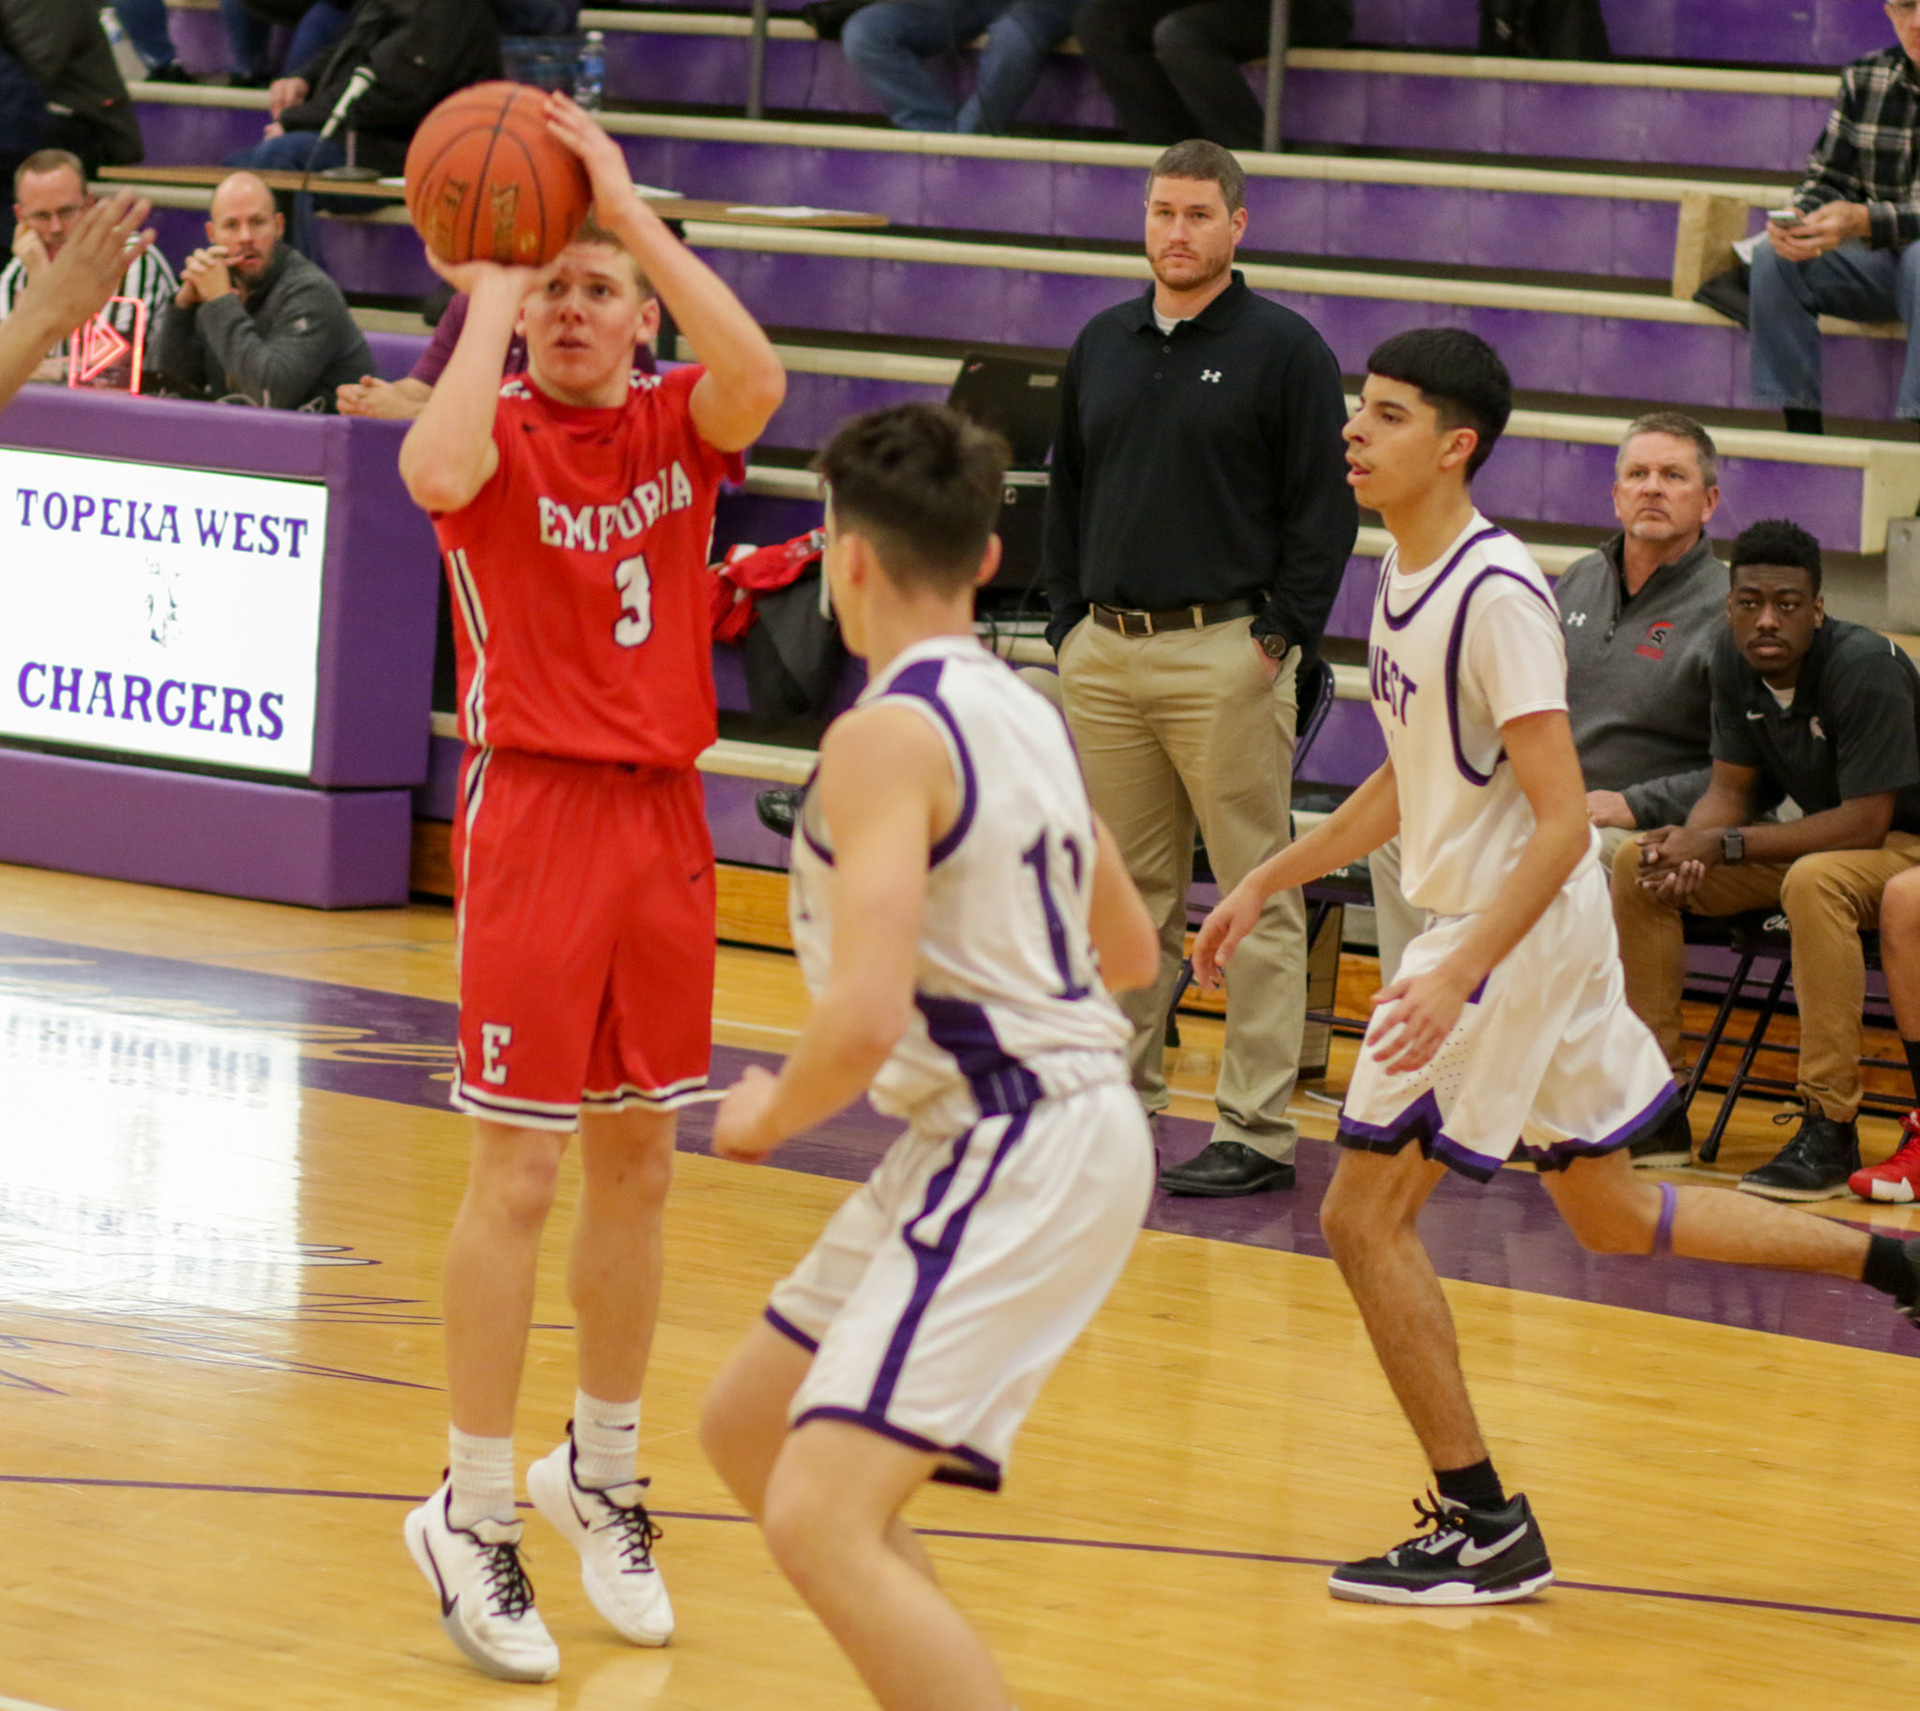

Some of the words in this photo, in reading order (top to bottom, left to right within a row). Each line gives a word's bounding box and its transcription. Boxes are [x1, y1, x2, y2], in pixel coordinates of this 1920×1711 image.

[16, 488, 181, 544] TOPEKA
[194, 508, 308, 558] WEST
[537, 460, 692, 552] EMPORIA
[613, 553, 652, 648] 3
[17, 660, 284, 741] CHARGERS
[481, 1022, 512, 1086] E
